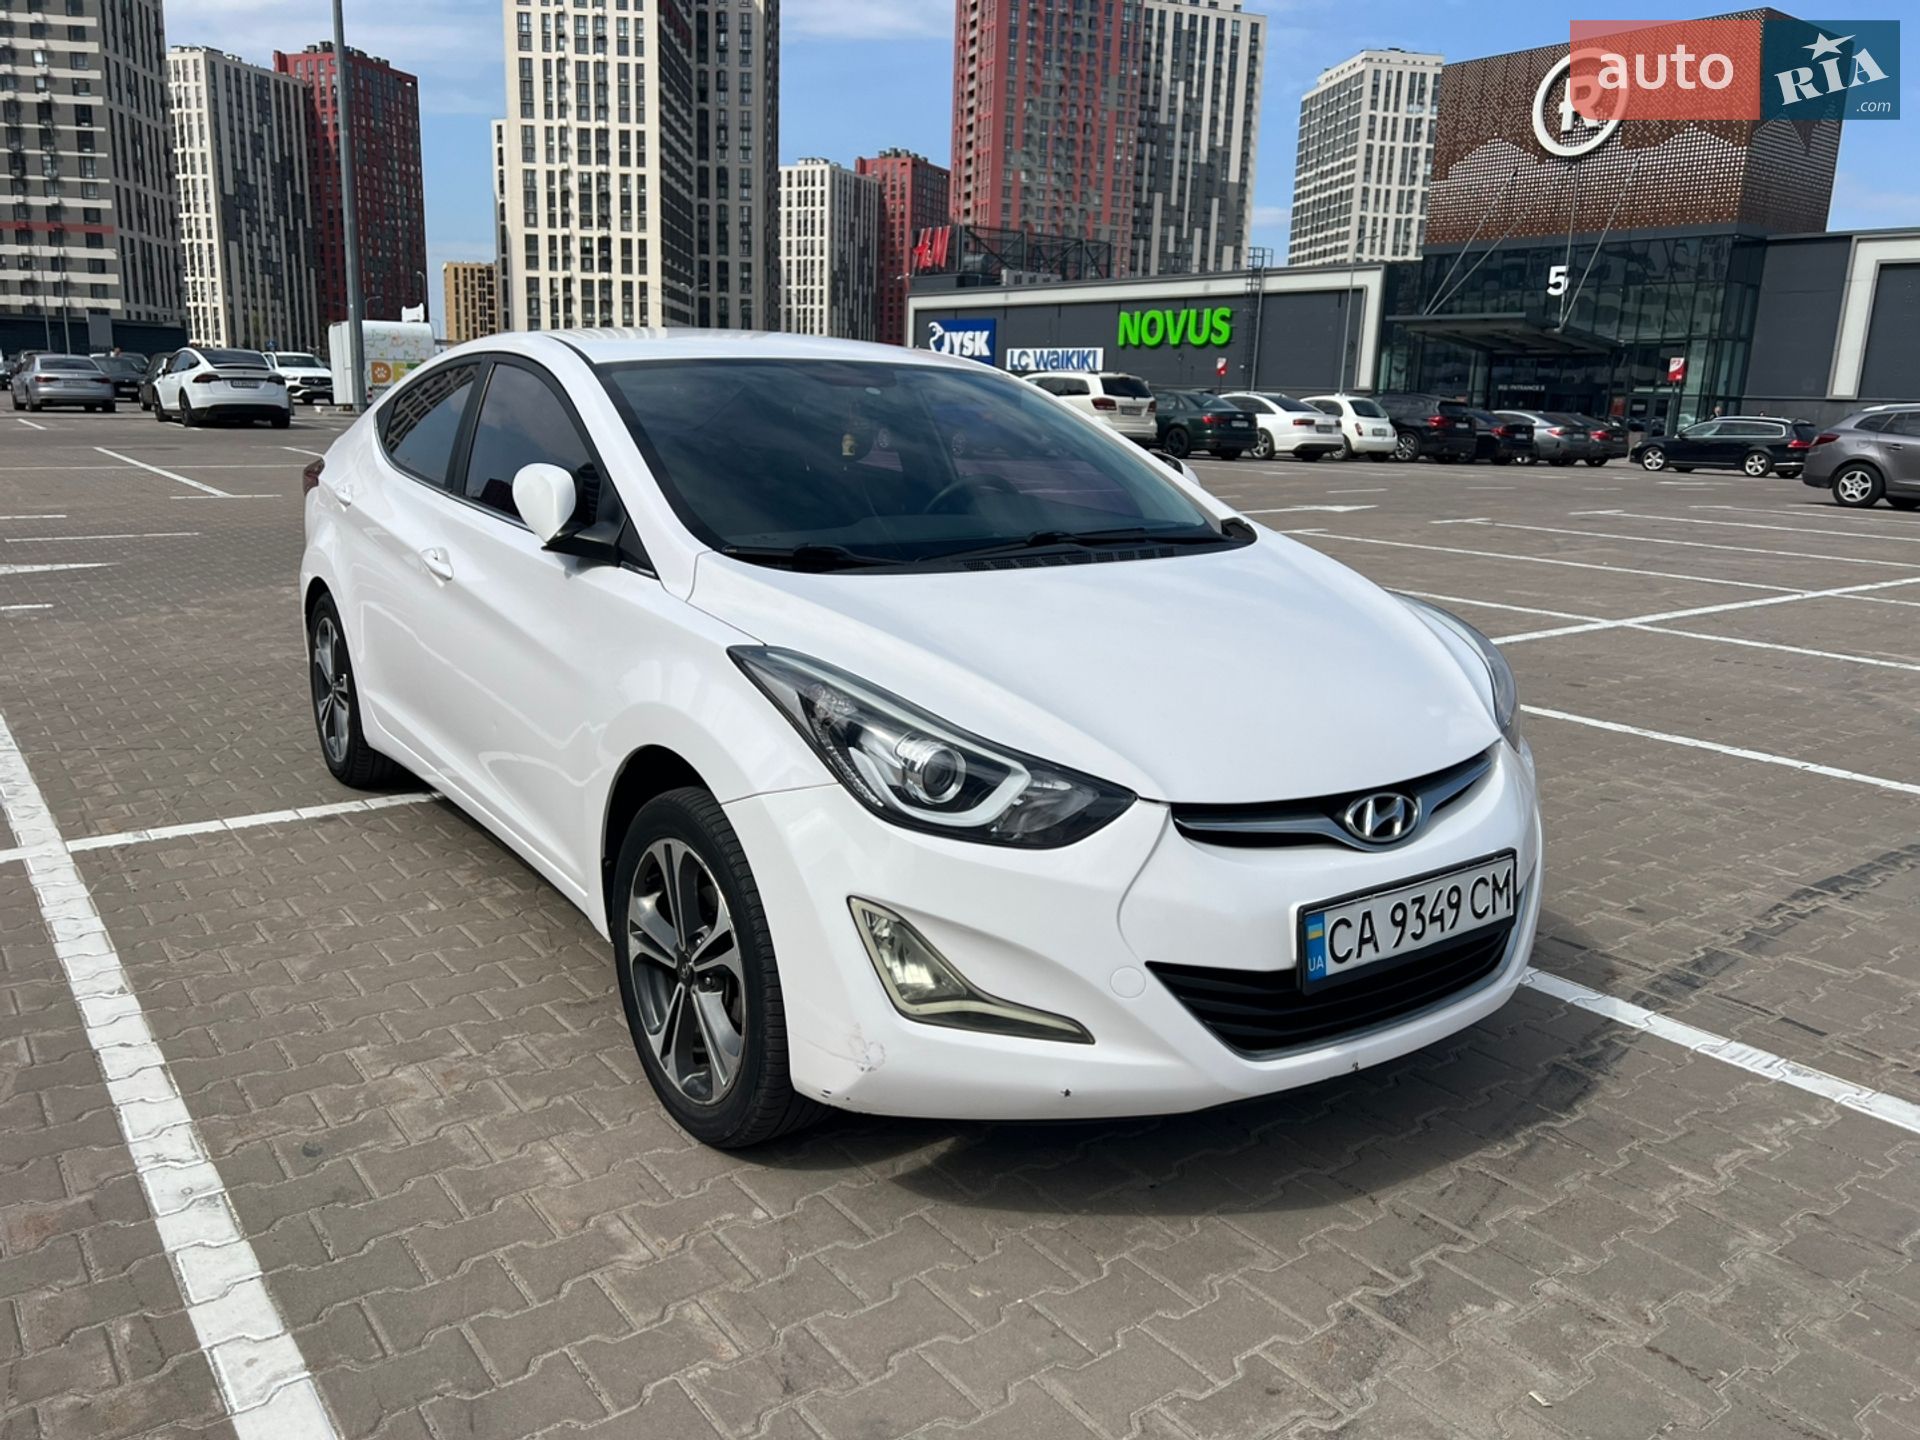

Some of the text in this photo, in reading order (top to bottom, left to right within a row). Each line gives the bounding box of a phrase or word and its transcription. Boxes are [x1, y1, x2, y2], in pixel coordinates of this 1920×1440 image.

[1547, 265, 1569, 296] 5
[1118, 307, 1231, 346] NOVUS
[941, 331, 991, 357] JYSK
[1009, 350, 1031, 370] LC
[1328, 868, 1511, 964] CA 9349 CM
[1308, 955, 1325, 972] UA
